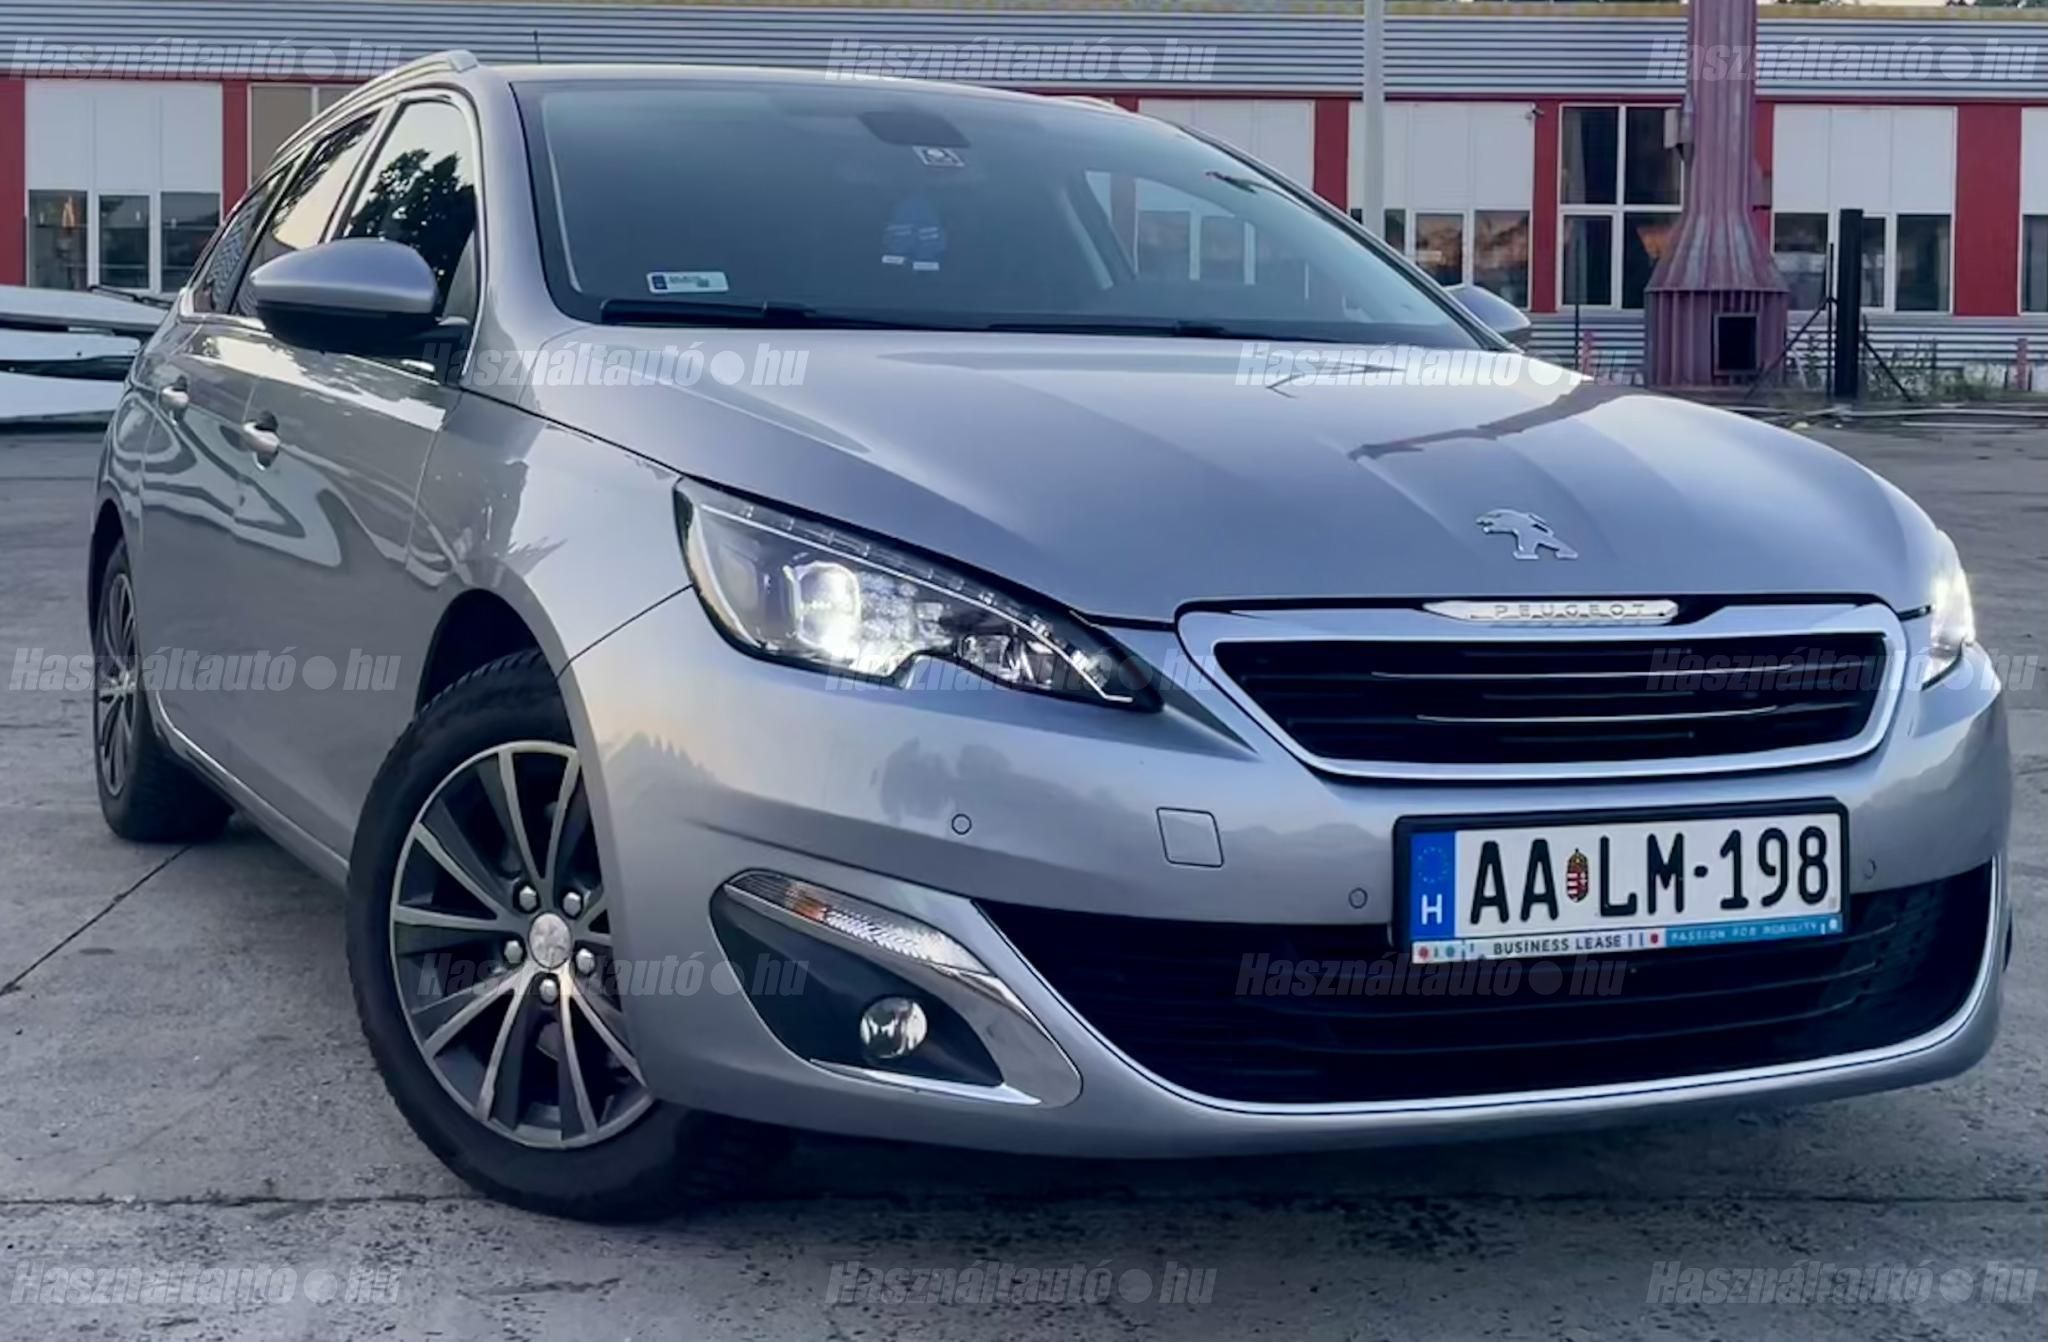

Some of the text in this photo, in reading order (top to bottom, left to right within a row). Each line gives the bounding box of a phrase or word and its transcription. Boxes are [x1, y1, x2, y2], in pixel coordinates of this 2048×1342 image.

[1494, 603, 1645, 617] PEUGEOT
[1470, 838, 1559, 925] AA
[1421, 894, 1443, 926] H
[1671, 921, 1817, 943] PASSION FOR MOBILITY
[1493, 934, 1621, 956] BUSINESS LEASE
